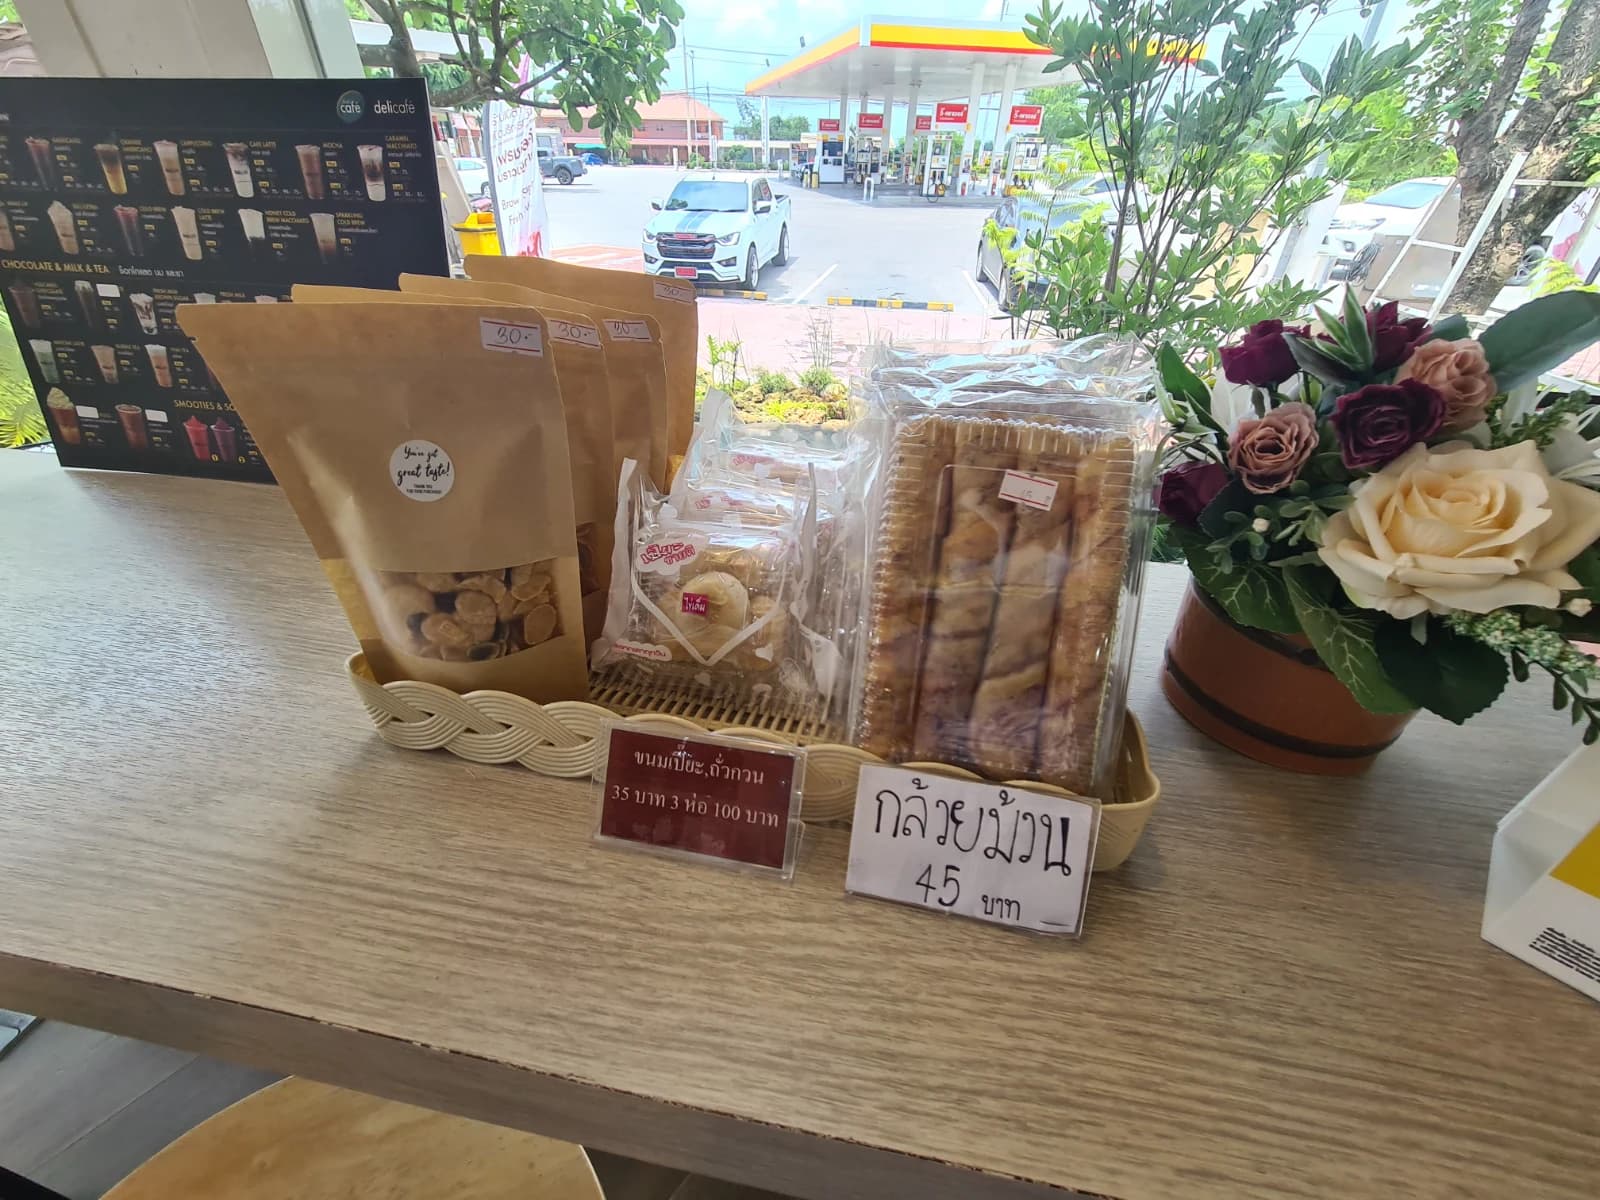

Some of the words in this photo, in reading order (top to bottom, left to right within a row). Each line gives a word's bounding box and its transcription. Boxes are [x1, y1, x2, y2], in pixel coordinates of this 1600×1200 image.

[374, 98, 416, 114] delicafé
[1, 260, 53, 271] CHOCOLATE
[55, 262, 62, 271] &
[63, 263, 84, 273] MILK
[86, 264, 93, 273] &
[94, 264, 110, 274] TEA
[397, 463, 422, 487] great
[425, 461, 450, 482] taste!
[611, 784, 629, 801] 35
[634, 788, 666, 808] บาท
[670, 795, 679, 810] 3
[684, 792, 708, 815] ห่อ
[713, 802, 741, 821] 100
[746, 808, 779, 828] บาท
[875, 777, 1072, 876] กล้วยม้วน
[915, 863, 961, 907] 45
[981, 894, 1021, 921] บาท
